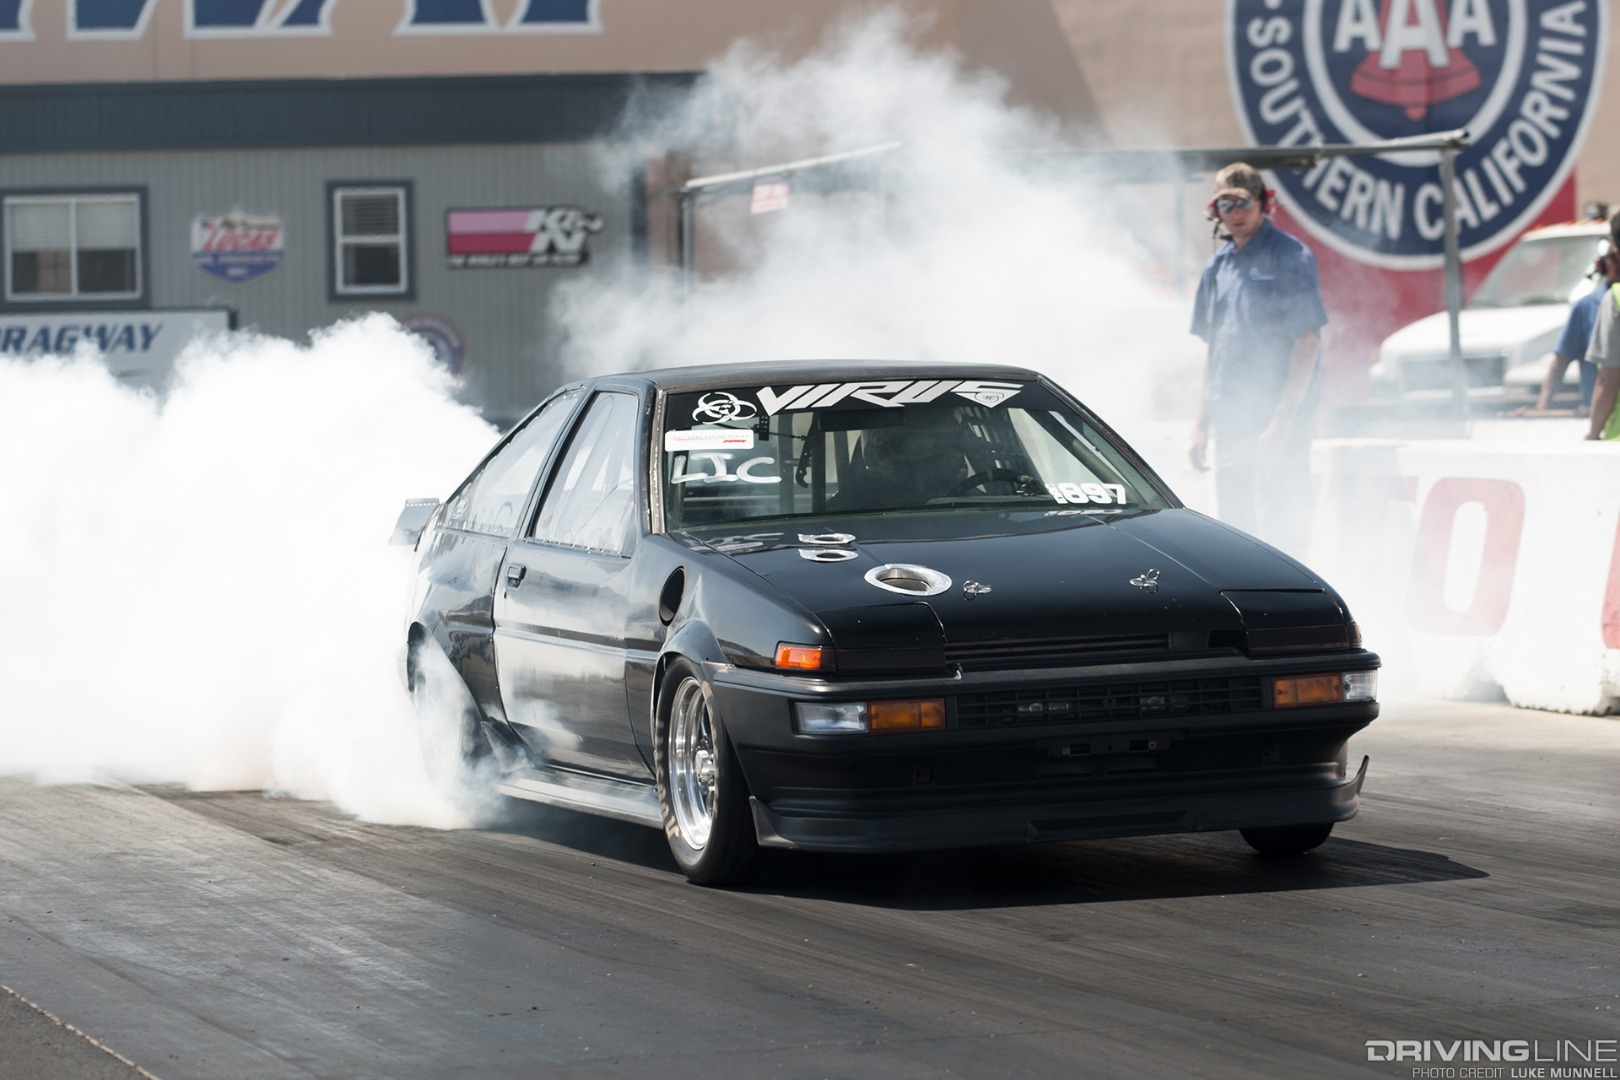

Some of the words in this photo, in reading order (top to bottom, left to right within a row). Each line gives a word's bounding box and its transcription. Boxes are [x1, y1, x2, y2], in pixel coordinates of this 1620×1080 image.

[1333, 0, 1497, 69] AAA
[0, 323, 162, 352] RAGWAY
[756, 380, 1024, 416] VIRUS
